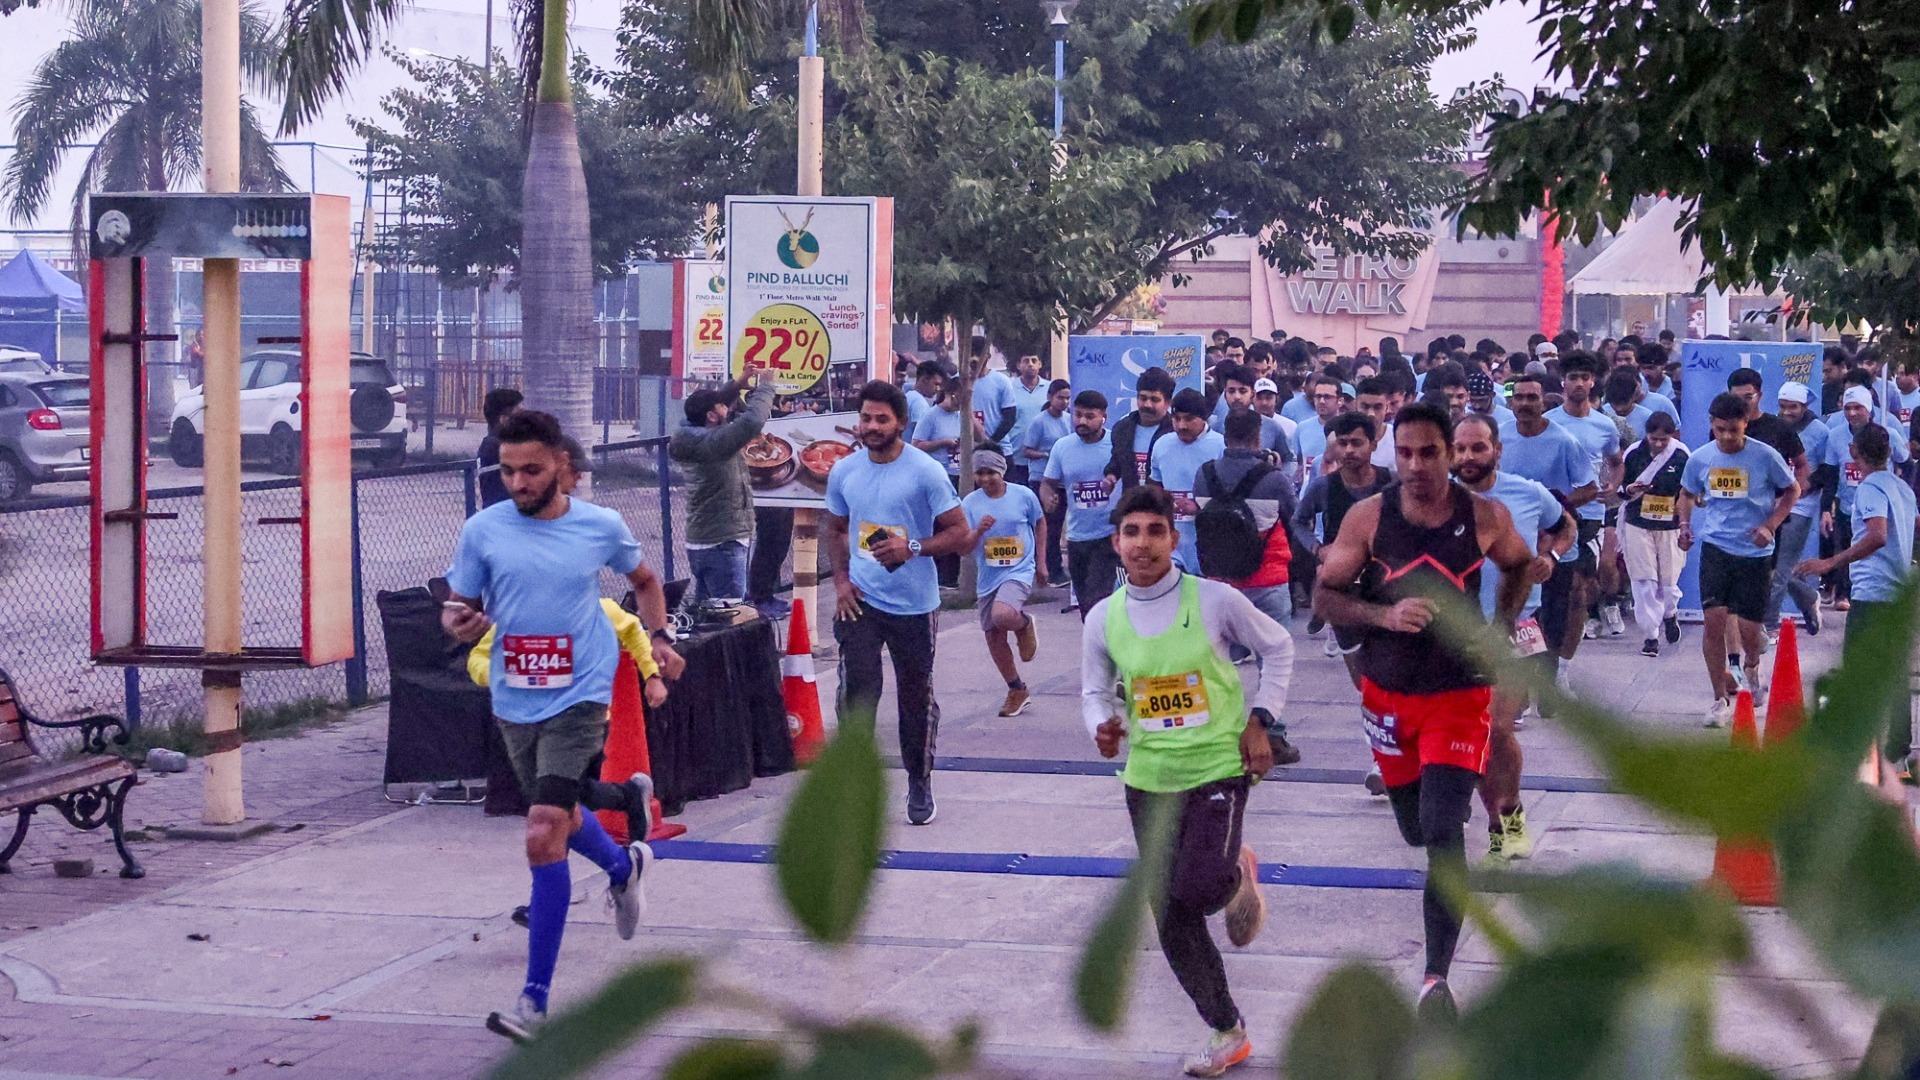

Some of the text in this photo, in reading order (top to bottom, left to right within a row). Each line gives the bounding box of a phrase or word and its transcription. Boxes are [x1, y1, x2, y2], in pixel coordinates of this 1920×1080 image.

[1281, 248, 1418, 279] ETRO
[747, 272, 848, 286] PIND BALLUCHI
[1287, 281, 1407, 315] WALK
[829, 303, 857, 311] Lunch
[760, 317, 781, 325] Enjoy
[821, 311, 865, 321] cravings?
[827, 321, 859, 330] Sorted!
[743, 327, 825, 371] 22%
[1717, 477, 1742, 488] 8016
[993, 546, 1017, 556] 8060
[517, 653, 560, 670] 1244
[1149, 691, 1193, 712] 8045
